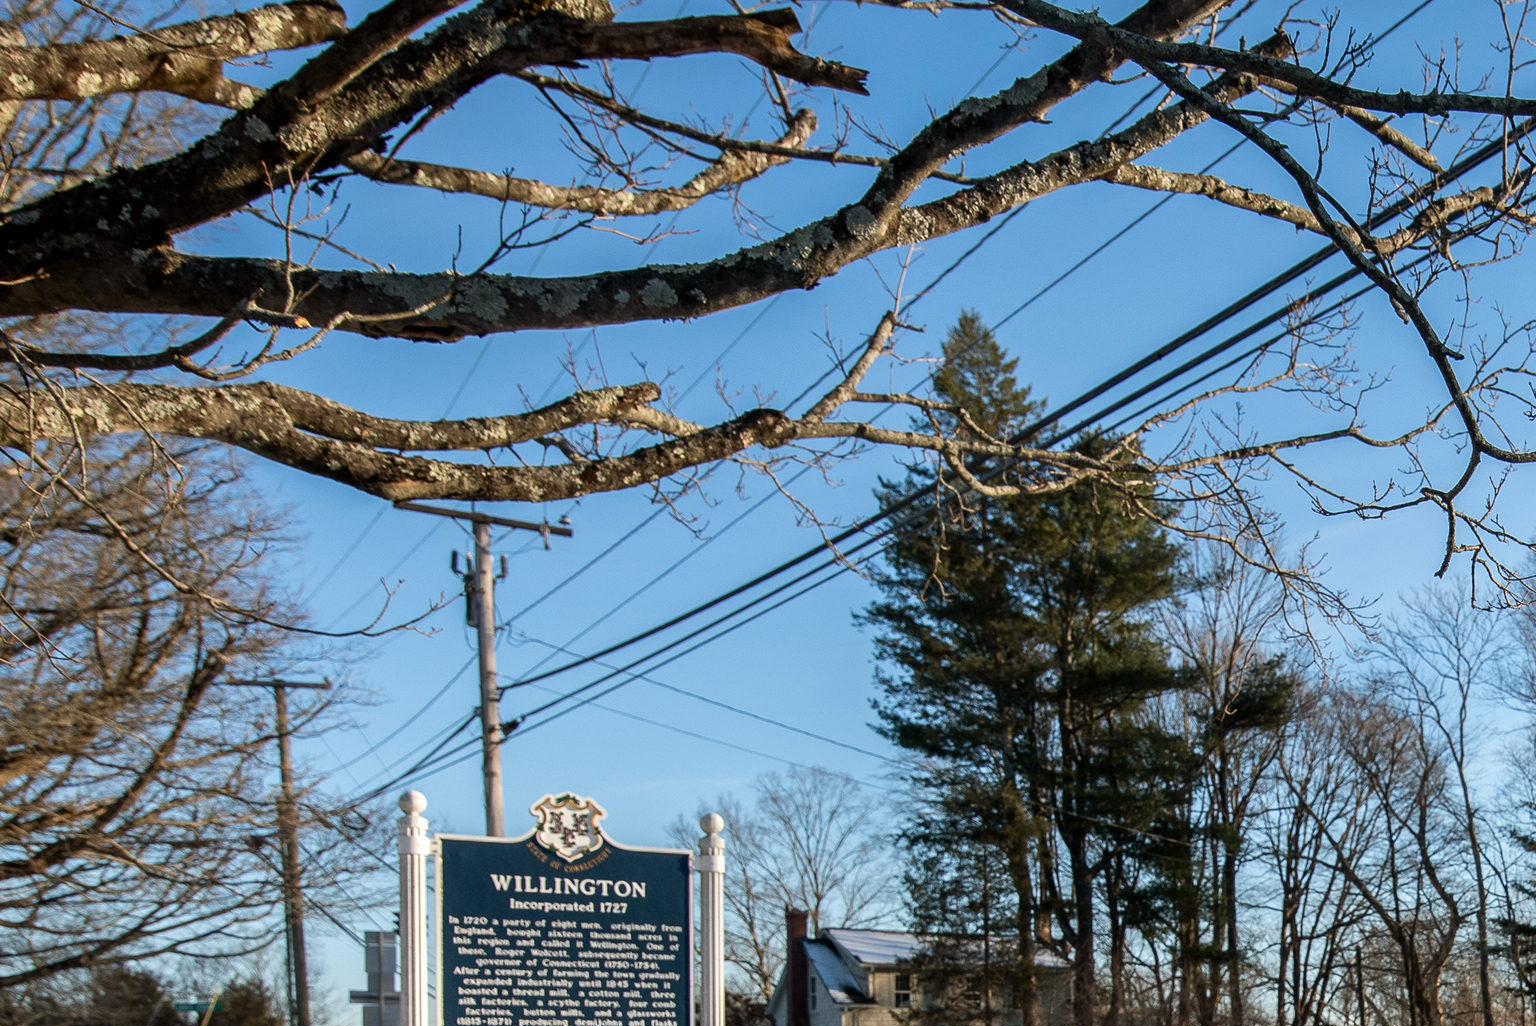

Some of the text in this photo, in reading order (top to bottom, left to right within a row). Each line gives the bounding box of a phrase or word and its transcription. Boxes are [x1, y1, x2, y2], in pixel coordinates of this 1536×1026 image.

[563, 847, 612, 872] CONNECTICUT
[490, 874, 646, 898] WILLINGTON
[510, 898, 628, 913] Incorporated 1727
[448, 915, 459, 924] In
[463, 916, 488, 925] 1720
[551, 920, 577, 929] eight
[610, 923, 657, 932] originally
[506, 929, 541, 938] bought
[452, 936, 471, 944] this
[477, 938, 510, 947] region
[541, 940, 570, 948] called
[646, 942, 664, 950] One
[495, 947, 525, 957] Roger
[542, 959, 600, 968] Connecticut
[453, 966, 480, 975] After
[494, 969, 533, 977] century
[552, 969, 590, 978] farming
[638, 972, 680, 980] gradually
[517, 979, 573, 987] industrially
[606, 980, 629, 988] 1845
[458, 987, 498, 995] boasted
[458, 997, 477, 1005] silk
[518, 1018, 568, 1026] producing
[574, 1019, 623, 1026] demijohns
